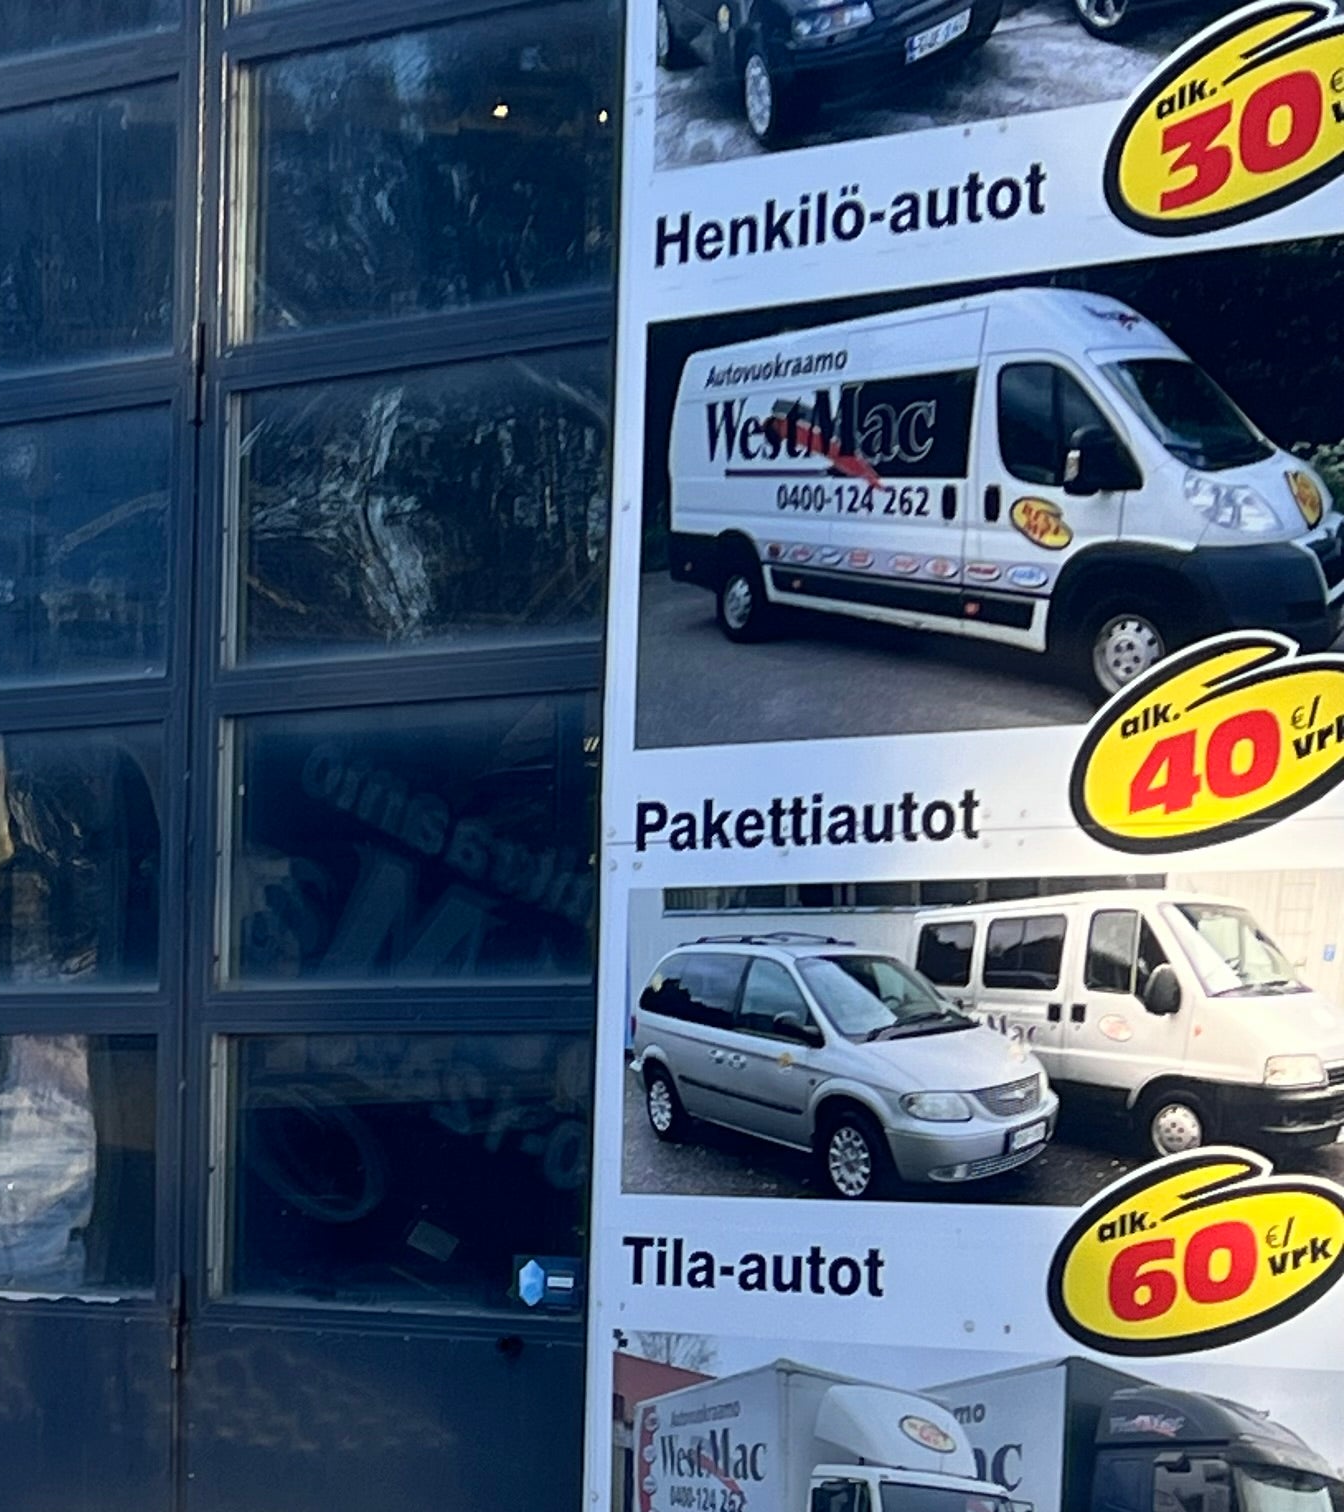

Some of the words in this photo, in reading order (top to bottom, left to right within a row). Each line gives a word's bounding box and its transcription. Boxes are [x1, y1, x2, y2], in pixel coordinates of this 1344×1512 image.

[1156, 78, 1217, 119] alk.
[1160, 70, 1323, 212] 30
[655, 163, 1047, 268] Henkilö-autot
[705, 350, 848, 388] Autovuokraamo
[777, 483, 874, 513] 0400-124
[883, 486, 929, 516] 262
[1120, 703, 1181, 739] alk.
[1129, 709, 1281, 815] 40
[636, 788, 980, 852] Pakettiautot
[1097, 1211, 1157, 1242] alk.
[623, 1235, 885, 1297] Tila-autot
[1108, 1220, 1257, 1322] 60
[1268, 1236, 1332, 1276] vrk
